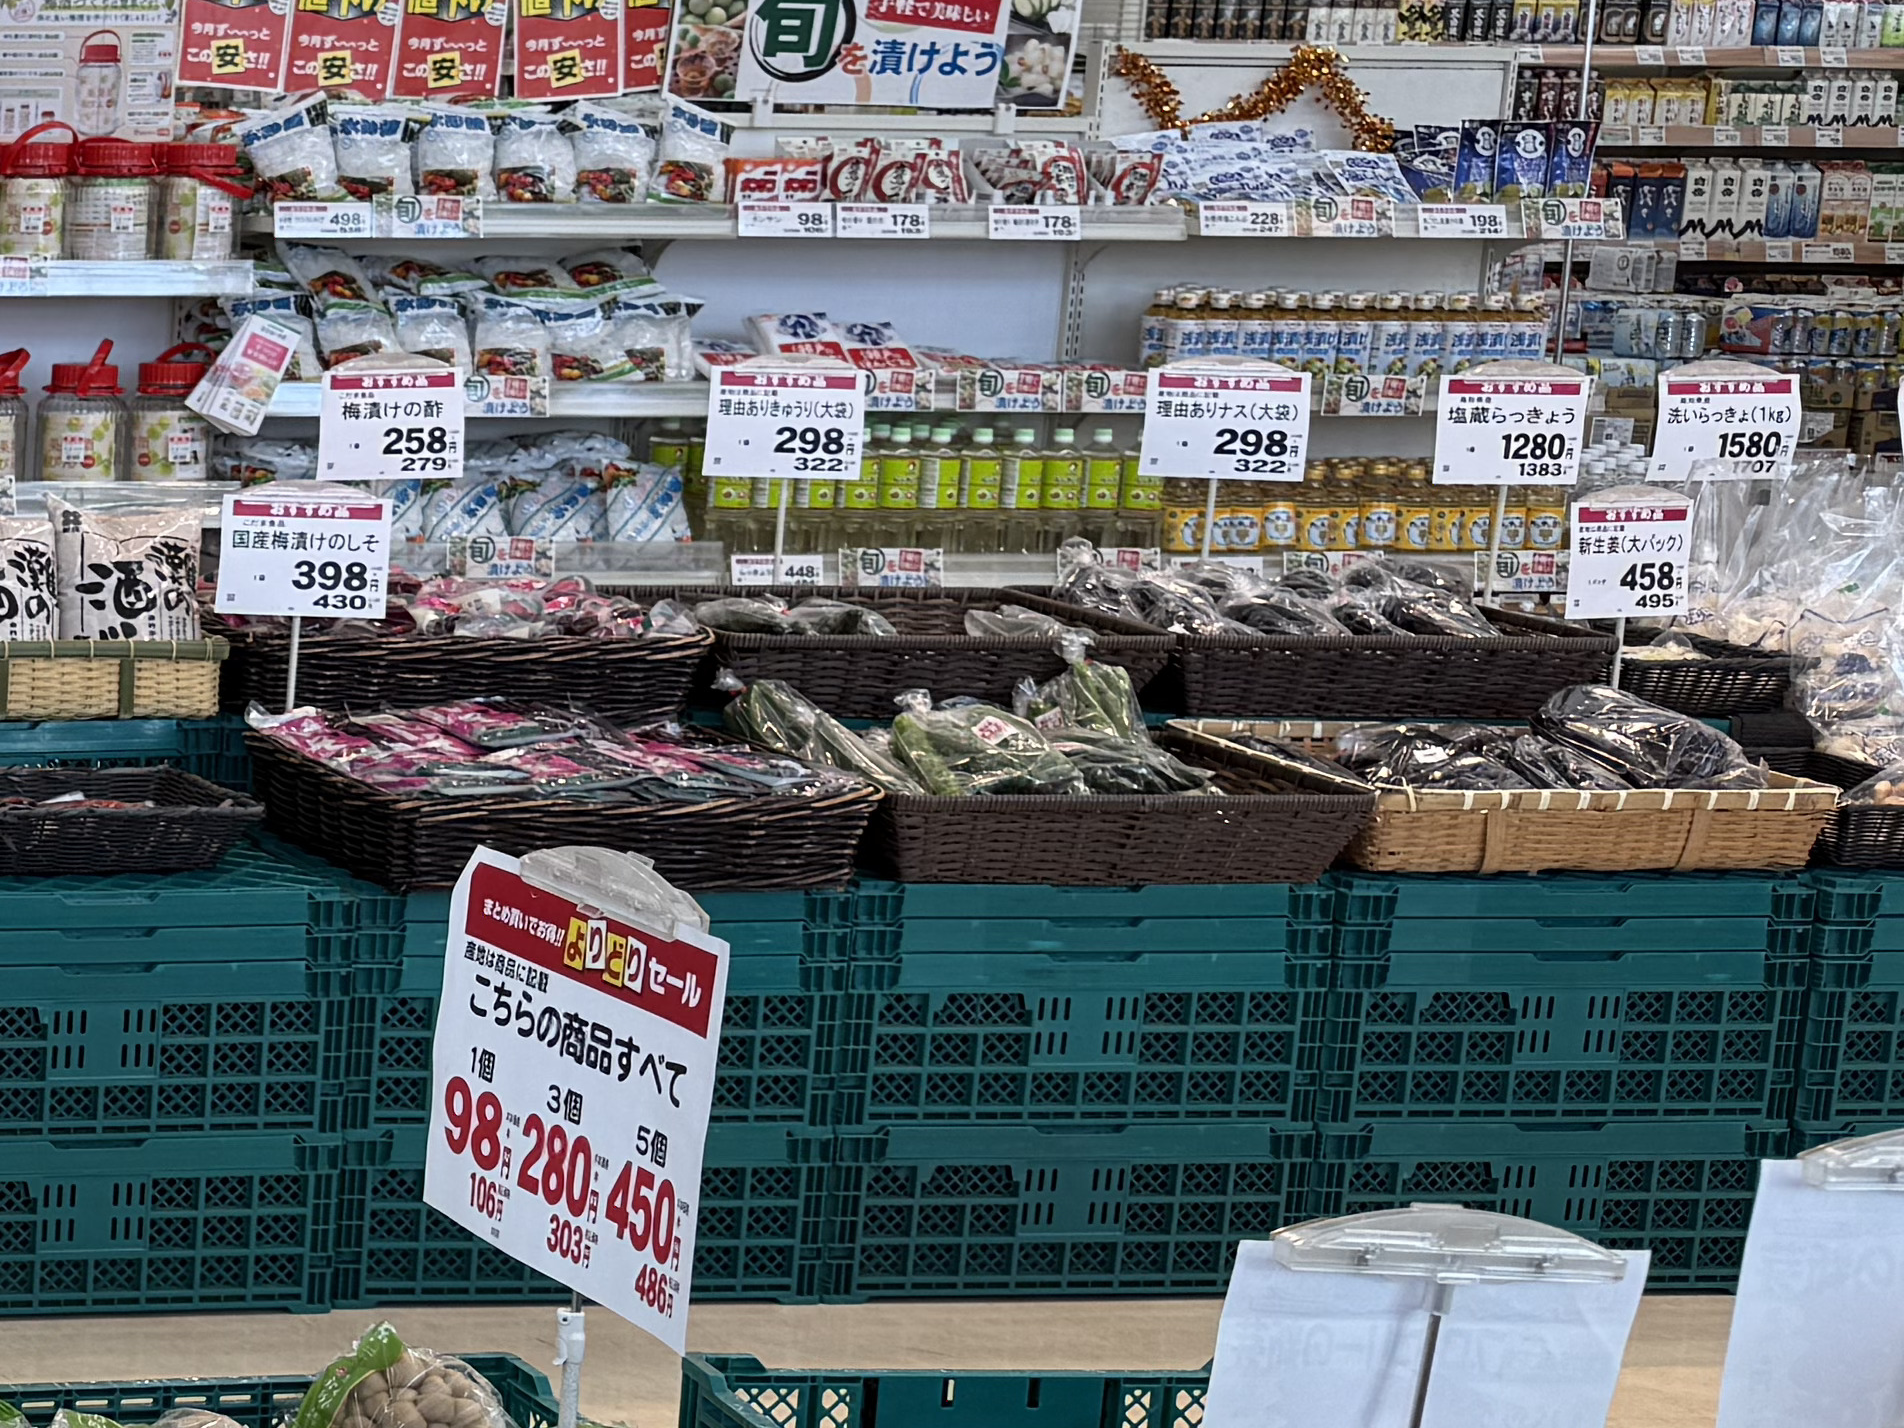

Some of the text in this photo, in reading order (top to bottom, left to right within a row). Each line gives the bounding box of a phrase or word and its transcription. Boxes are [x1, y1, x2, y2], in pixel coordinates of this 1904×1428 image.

[1468, 213, 1498, 230] 198
[341, 399, 443, 423] 梅漬けの酢
[1446, 404, 1577, 426] 塩蔵らっきょう
[382, 427, 448, 455] 258
[773, 426, 844, 454] 298
[1213, 428, 1288, 457] 298
[1500, 433, 1567, 461] 1280
[1717, 431, 1782, 459] 1580
[401, 456, 448, 471] 279
[268, 501, 351, 519] おすすめ品
[230, 529, 380, 554] 国産梅漬けのしそ
[291, 561, 367, 591] 398
[1619, 561, 1675, 592] 458
[648, 957, 702, 1008] セール
[469, 972, 689, 1109] こちらの商品すべて
[444, 1075, 504, 1172] 98
[517, 1113, 591, 1219] 280
[605, 1160, 676, 1265] 450
